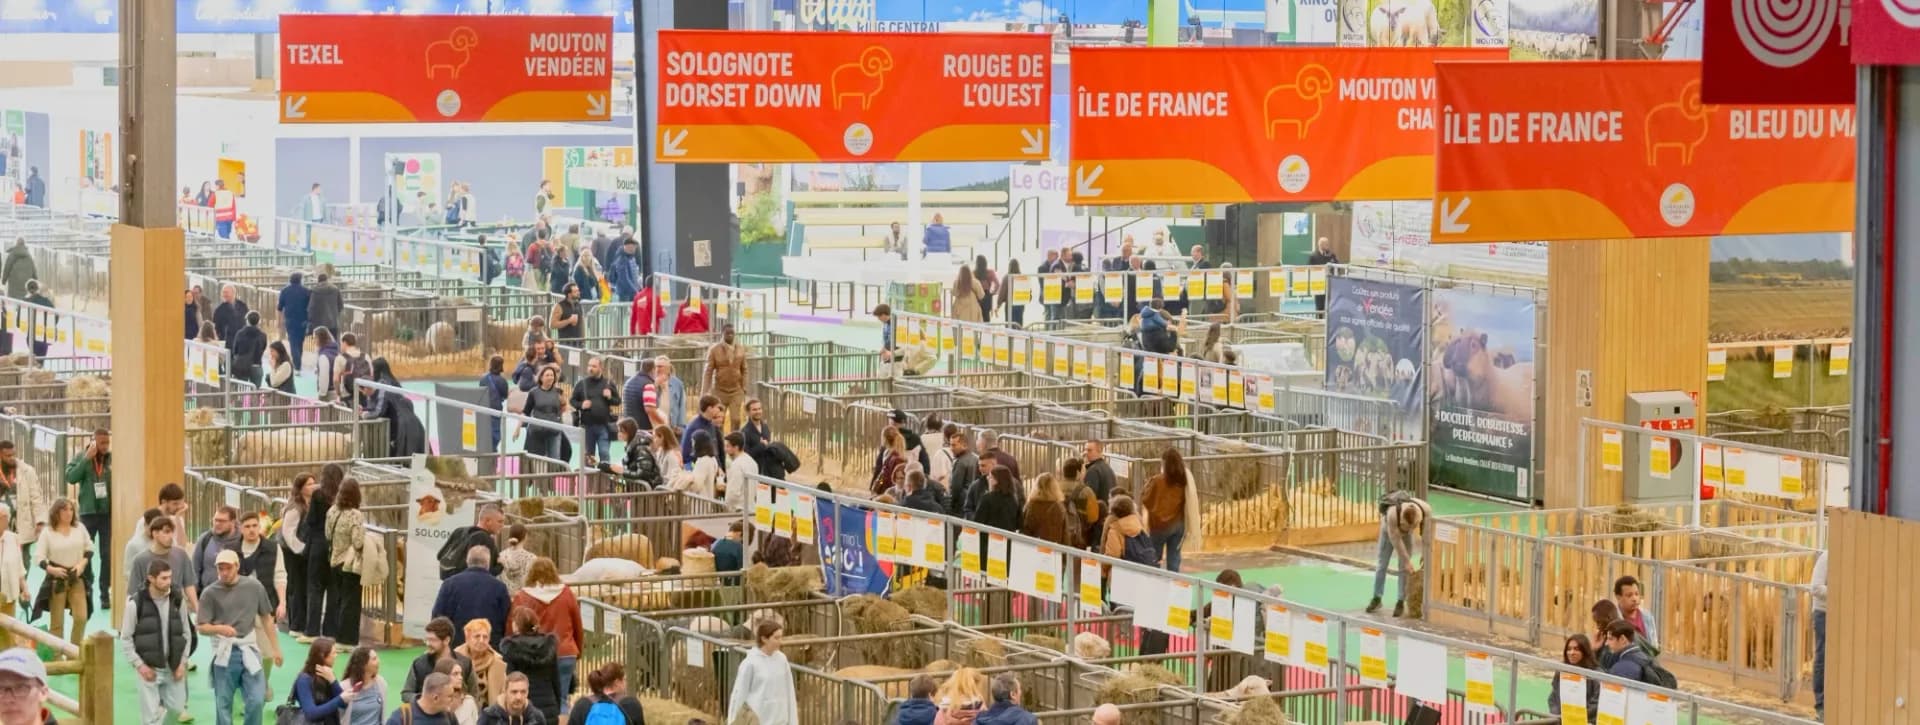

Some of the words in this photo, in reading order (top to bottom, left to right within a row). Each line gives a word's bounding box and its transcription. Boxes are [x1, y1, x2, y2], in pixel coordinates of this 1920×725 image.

[287, 44, 343, 65] TEXEL
[530, 32, 606, 53] MOUTON
[525, 51, 606, 77] VENDÉEN
[666, 51, 793, 77] SOLOGNOTE
[943, 54, 1012, 78] ROUGE
[1018, 54, 1044, 78] DE
[665, 82, 750, 108] DORSET
[755, 83, 821, 108] DOWN
[963, 83, 1044, 107] L'OUEST
[1078, 85, 1110, 117] ÎLE
[1115, 92, 1142, 117] DE
[1148, 92, 1228, 117] FRANCE
[1339, 78, 1417, 101] MOUTON
[1444, 104, 1481, 144] ÎLE
[1489, 112, 1520, 143] DE
[1528, 111, 1623, 143] FRANCE
[1729, 109, 1787, 139] BLEU
[1793, 109, 1824, 138] DU
[1013, 169, 1032, 190] Le
